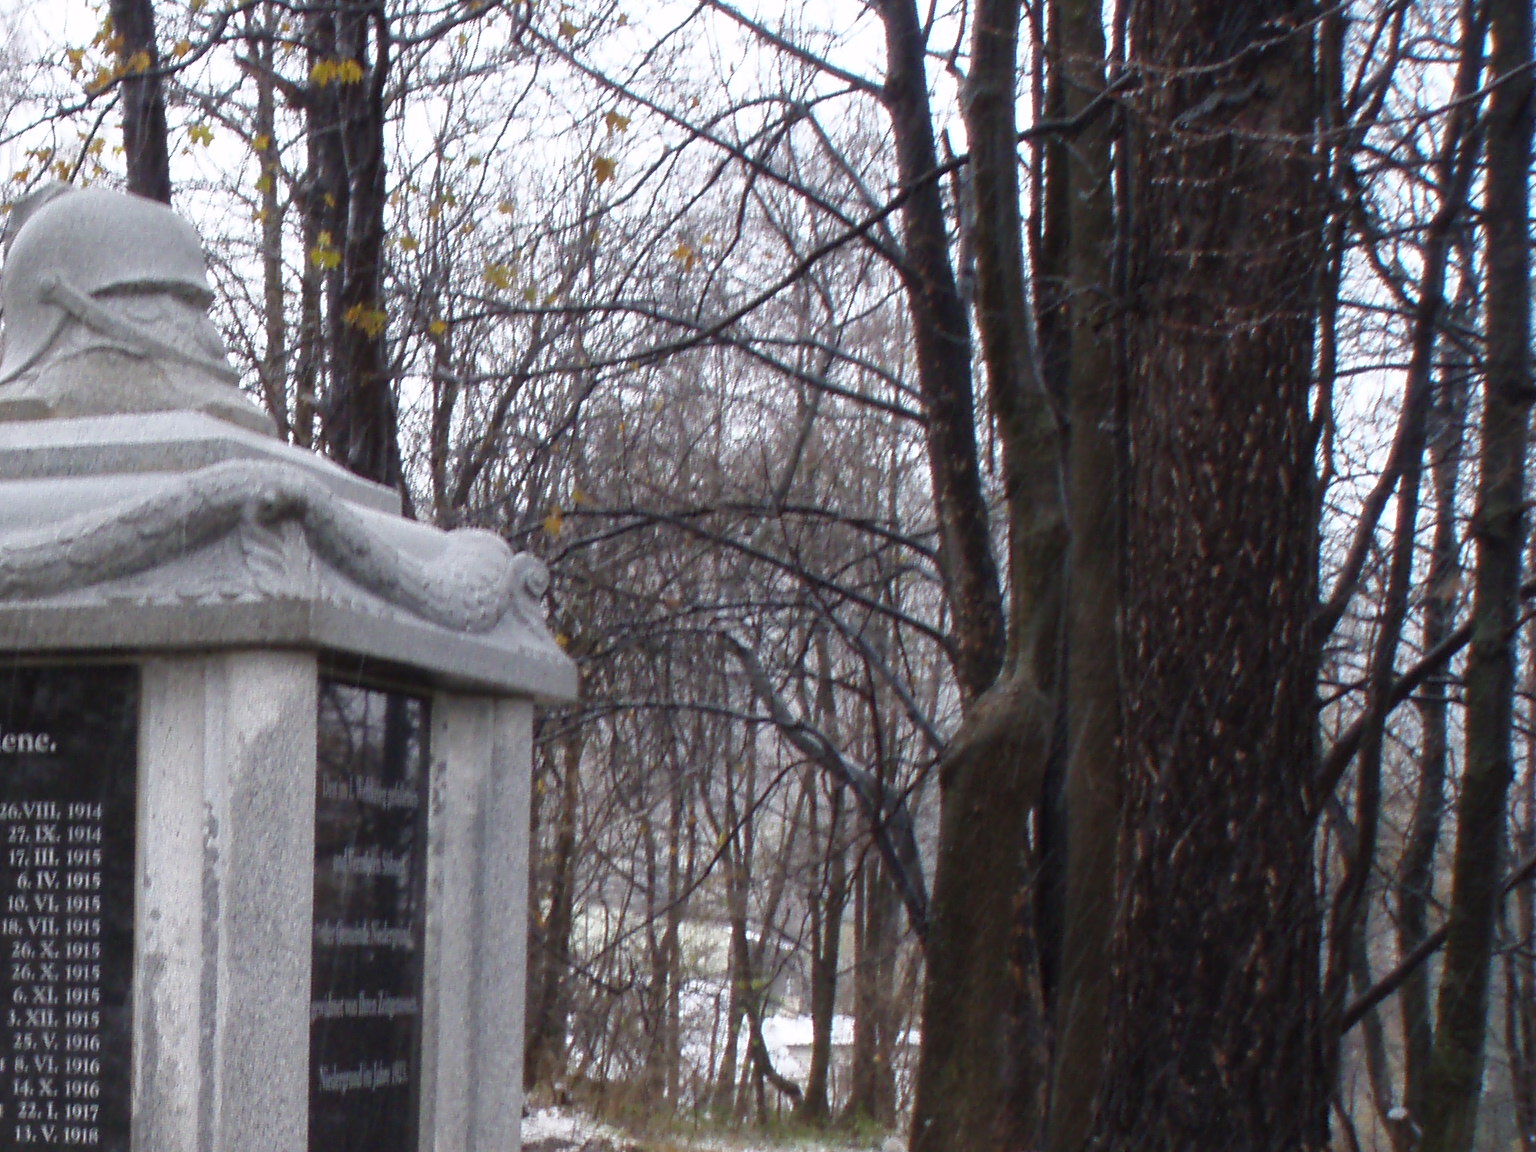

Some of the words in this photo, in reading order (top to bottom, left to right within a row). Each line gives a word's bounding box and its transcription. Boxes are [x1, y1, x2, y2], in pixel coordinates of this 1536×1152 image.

[68, 802, 102, 819] 1914
[67, 825, 102, 843] 1914
[66, 848, 102, 866] 1915
[66, 871, 101, 889] 1915
[65, 895, 101, 912] 1915
[65, 918, 101, 936] 1915
[65, 942, 101, 959] 1915
[65, 964, 100, 981] 1915
[65, 987, 100, 1005] 1915
[65, 1010, 100, 1028] 1915
[65, 1034, 100, 1051] 1916
[65, 1057, 100, 1074] 1916
[64, 1080, 100, 1098] 1916
[64, 1103, 99, 1122] 1917
[63, 1126, 99, 1144] 1918
